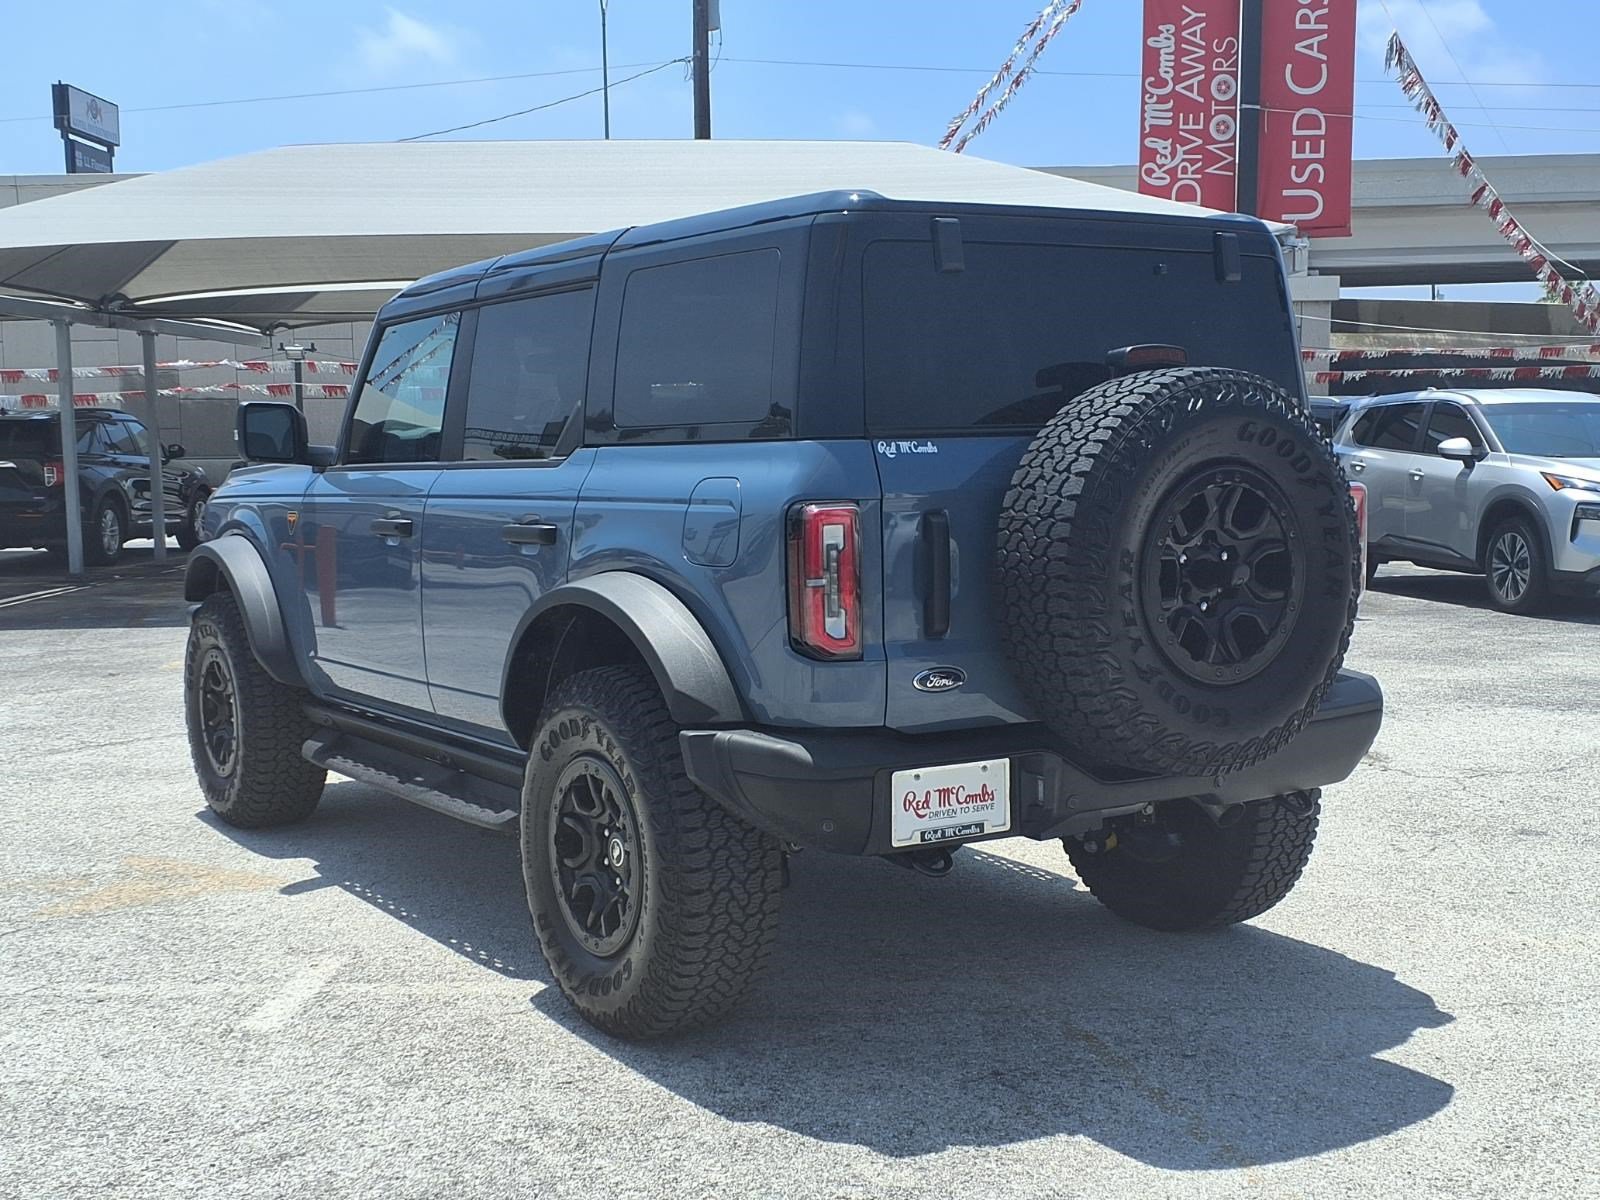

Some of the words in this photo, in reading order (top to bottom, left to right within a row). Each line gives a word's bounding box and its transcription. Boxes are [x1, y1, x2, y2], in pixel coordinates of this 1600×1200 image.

[1144, 24, 1176, 133] McCombs
[1175, 4, 1206, 103] AWAY
[1285, 0, 1329, 95] CAR
[1203, 36, 1238, 176] MOTORS
[1141, 137, 1184, 187] Red
[1171, 112, 1204, 206] DRIVE
[1281, 107, 1327, 222] USED
[877, 440, 897, 458] Red
[896, 440, 938, 453] McCombs
[926, 673, 954, 688] Ford
[903, 790, 931, 819] Red
[933, 783, 995, 808] McCombs
[924, 829, 942, 840] Red
[928, 808, 957, 819] DRIVEN
[960, 806, 970, 814] TO
[972, 803, 995, 812] SERVE
